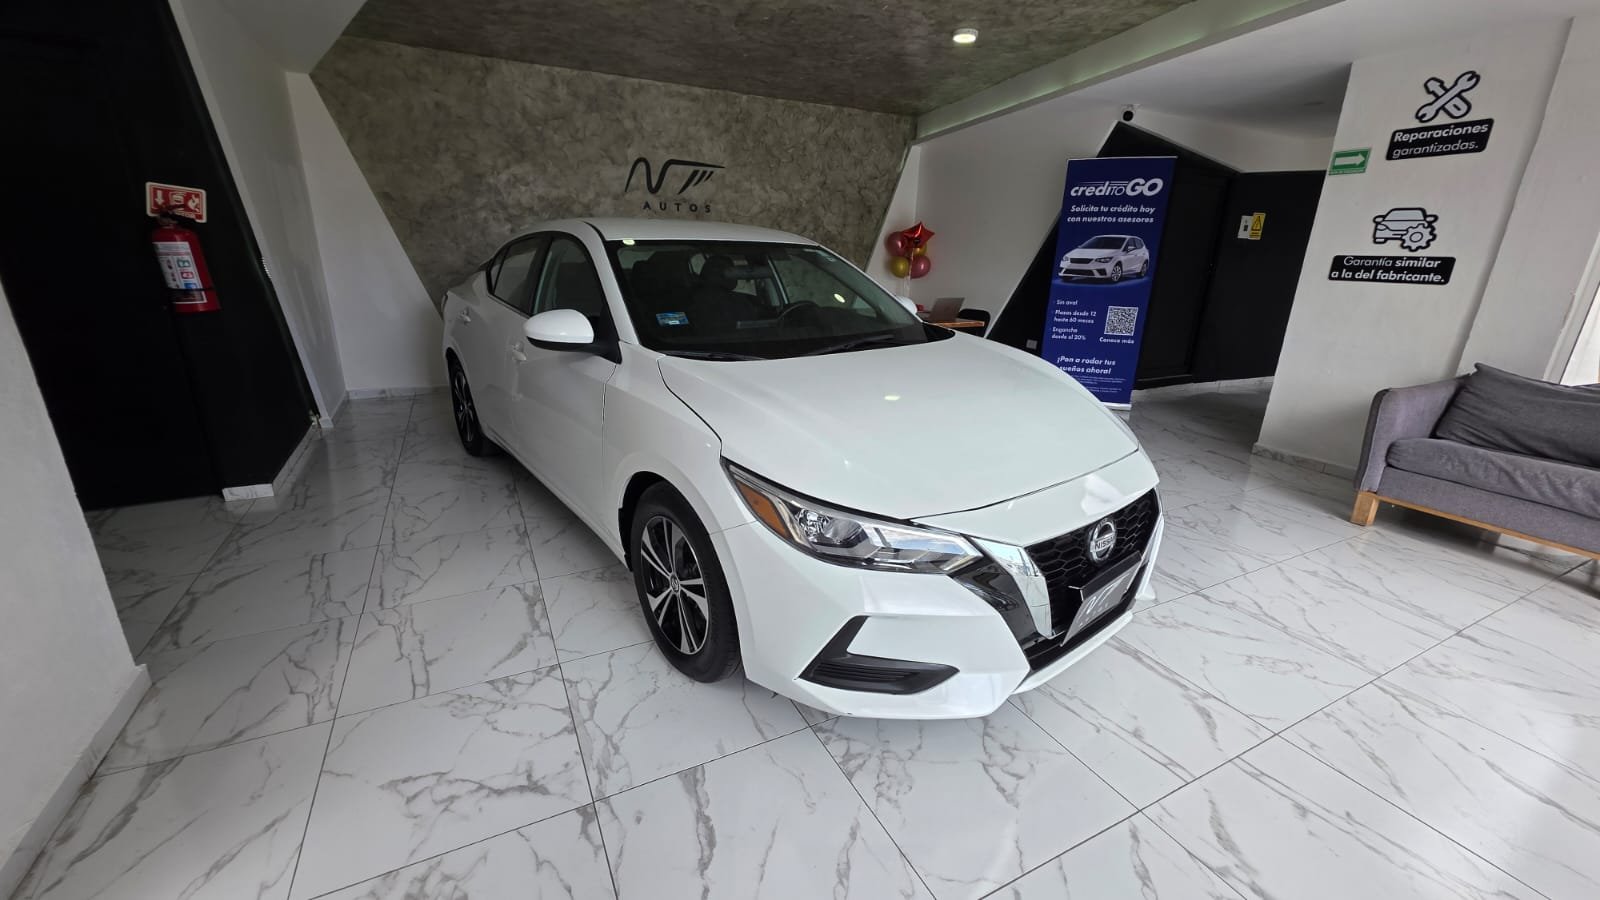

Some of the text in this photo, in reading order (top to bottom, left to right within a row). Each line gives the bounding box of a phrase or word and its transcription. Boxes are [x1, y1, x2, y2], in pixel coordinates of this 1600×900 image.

[1393, 122, 1489, 143] Reparaciones
[1392, 139, 1479, 159] garantizadas.
[643, 201, 711, 214] AUTOS
[1070, 204, 1099, 213] Solicita
[1110, 204, 1138, 213] crédito
[1139, 204, 1156, 214] hoy
[1082, 215, 1116, 223] nuestros
[1343, 256, 1441, 268] Garantía similar
[1331, 269, 1445, 283] a la del fabricante.
[1081, 356, 1104, 365] rodar
